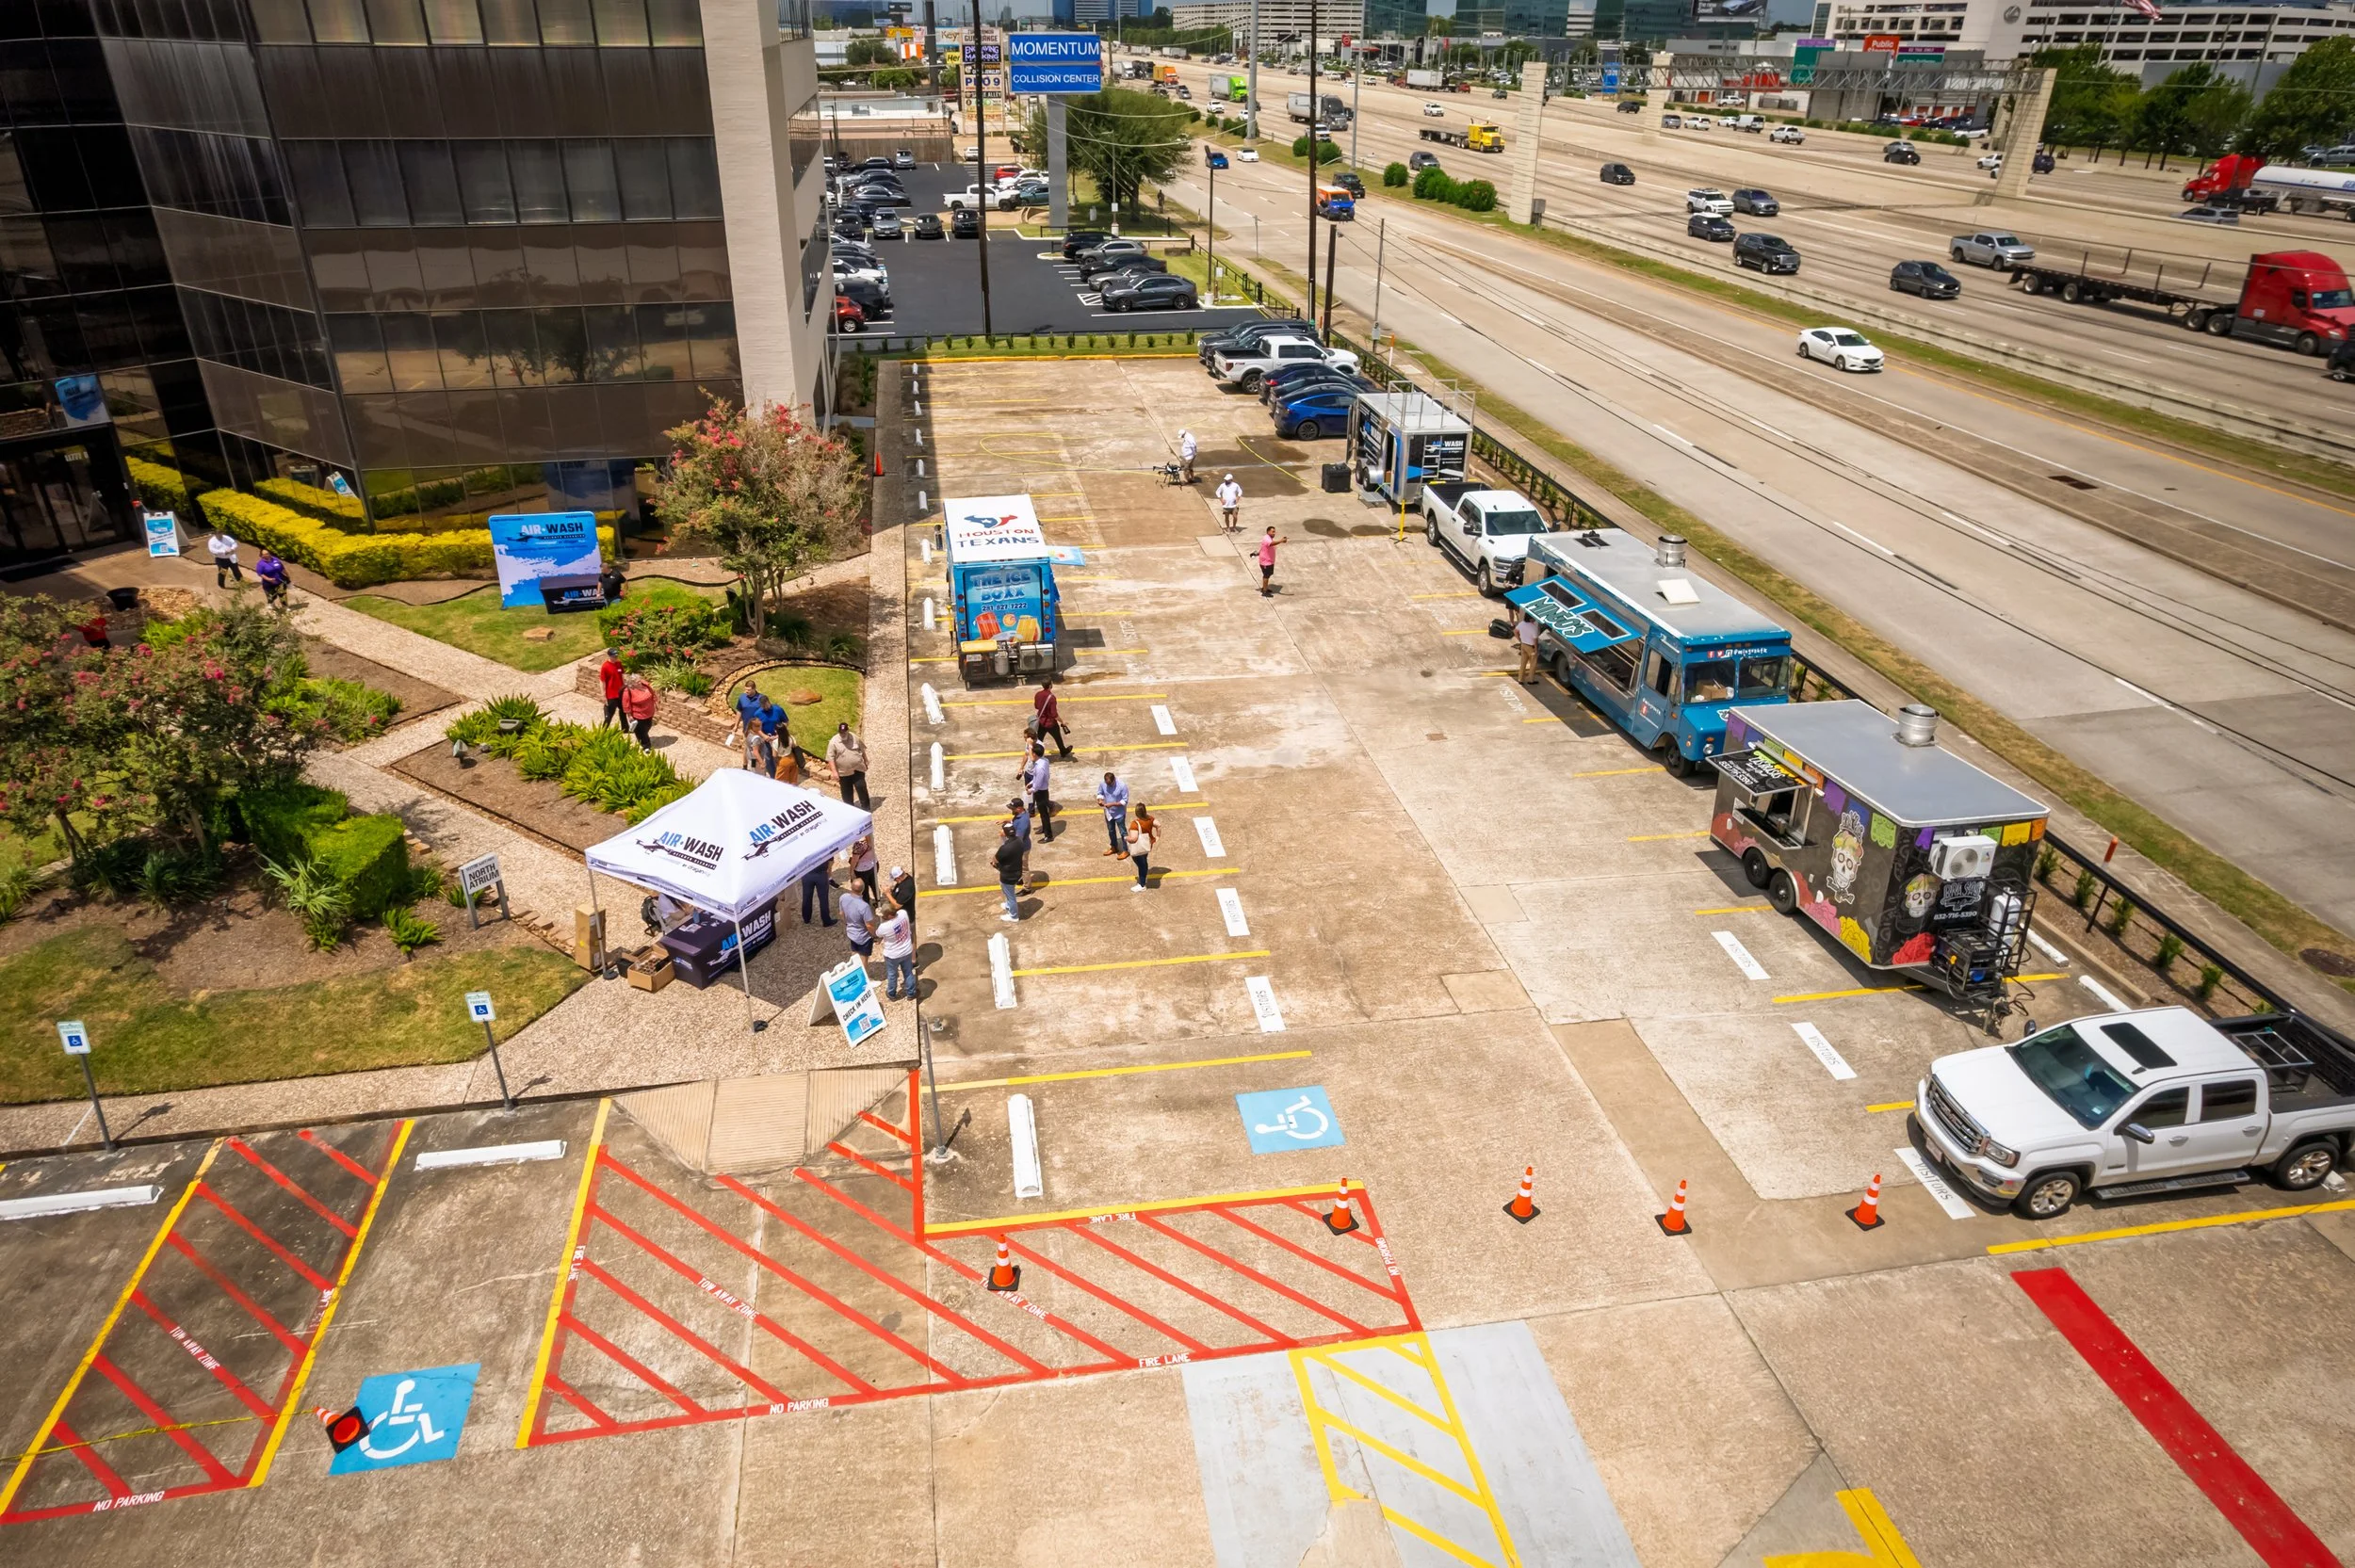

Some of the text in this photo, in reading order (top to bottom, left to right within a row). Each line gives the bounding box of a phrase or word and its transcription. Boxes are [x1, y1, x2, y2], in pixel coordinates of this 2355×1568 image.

[1011, 42, 1099, 56] MOMENTUM
[1013, 74, 1099, 83] COLLISION CENTER
[959, 528, 1034, 538] HOUSTON
[955, 537, 1039, 548] TEXANS
[469, 863, 496, 881] NORTH
[470, 869, 500, 889] ATRIUM
[1729, 943, 1754, 969] VISITORS
[843, 1007, 856, 1021] CHECK
[1808, 1035, 1841, 1067] VISITORS
[1914, 1162, 1954, 1201] VISITORS
[1088, 1211, 1137, 1224] FIRE LANE
[572, 1245, 585, 1261] FIRE
[1375, 1237, 1401, 1276] NO PARKING
[697, 1277, 760, 1320] TOW AWAY ZONE
[997, 1290, 1024, 1305] AWAY
[1023, 1301, 1049, 1319] ZONE
[169, 1326, 221, 1370] TOW AWAY ZONE
[1138, 1352, 1191, 1368] FIRE LANE
[769, 1398, 829, 1415] NO PARKING
[93, 1490, 165, 1512] NO PARKING
